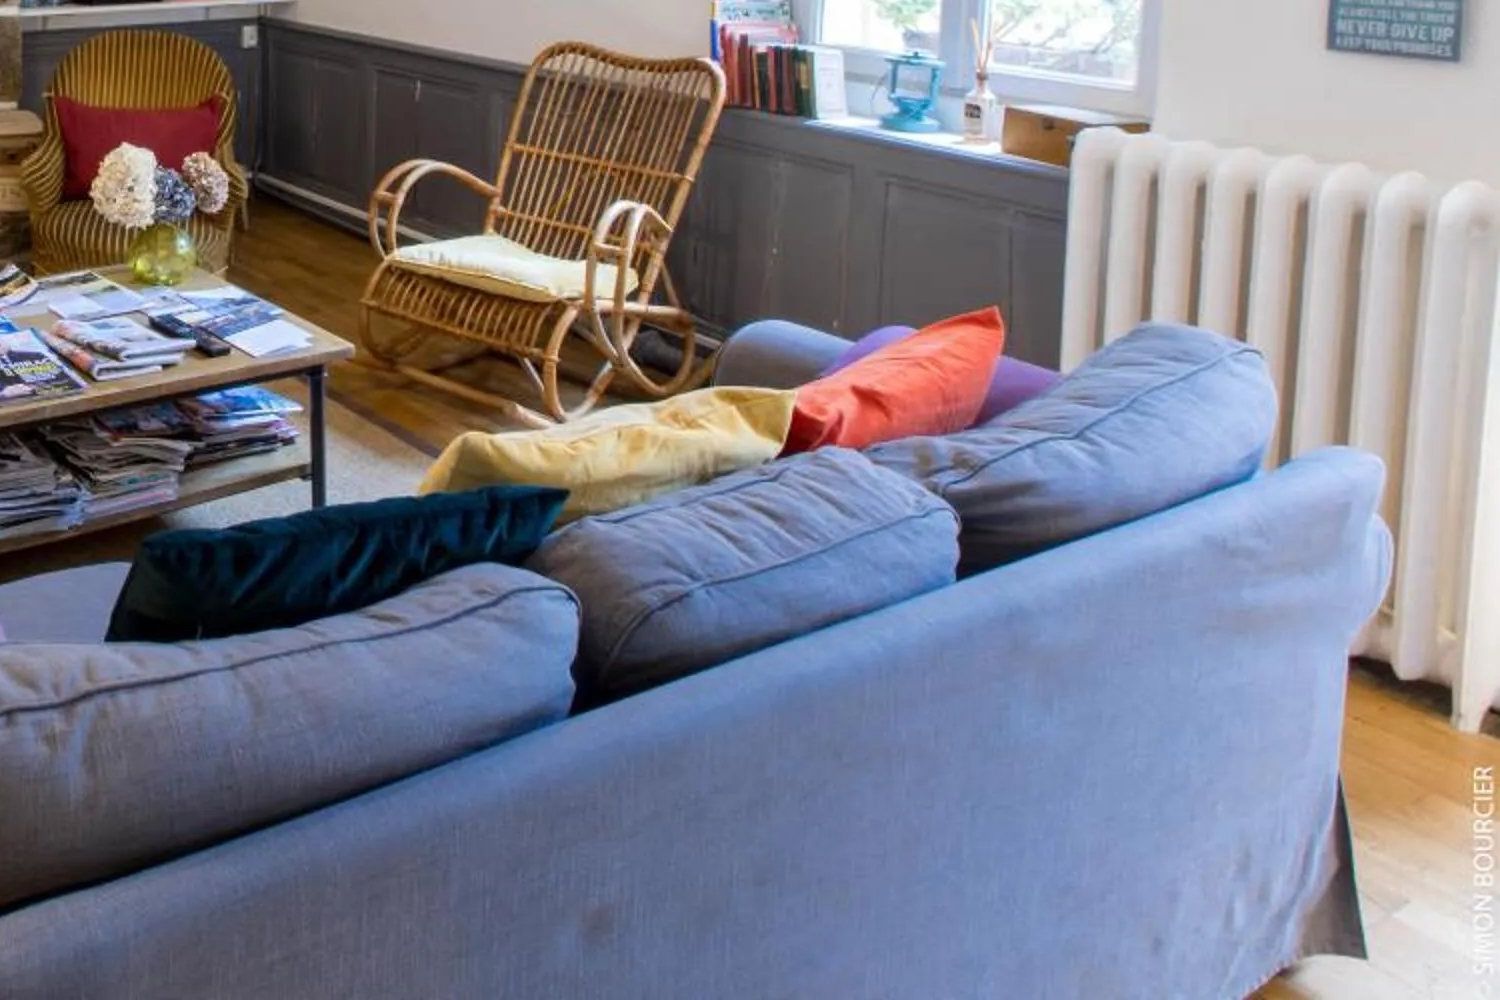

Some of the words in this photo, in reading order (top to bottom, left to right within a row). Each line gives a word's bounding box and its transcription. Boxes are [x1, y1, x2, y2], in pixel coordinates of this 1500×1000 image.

[1337, 18, 1387, 37] NEVER
[1390, 22, 1427, 40] GIVE
[1431, 26, 1455, 42] UP
